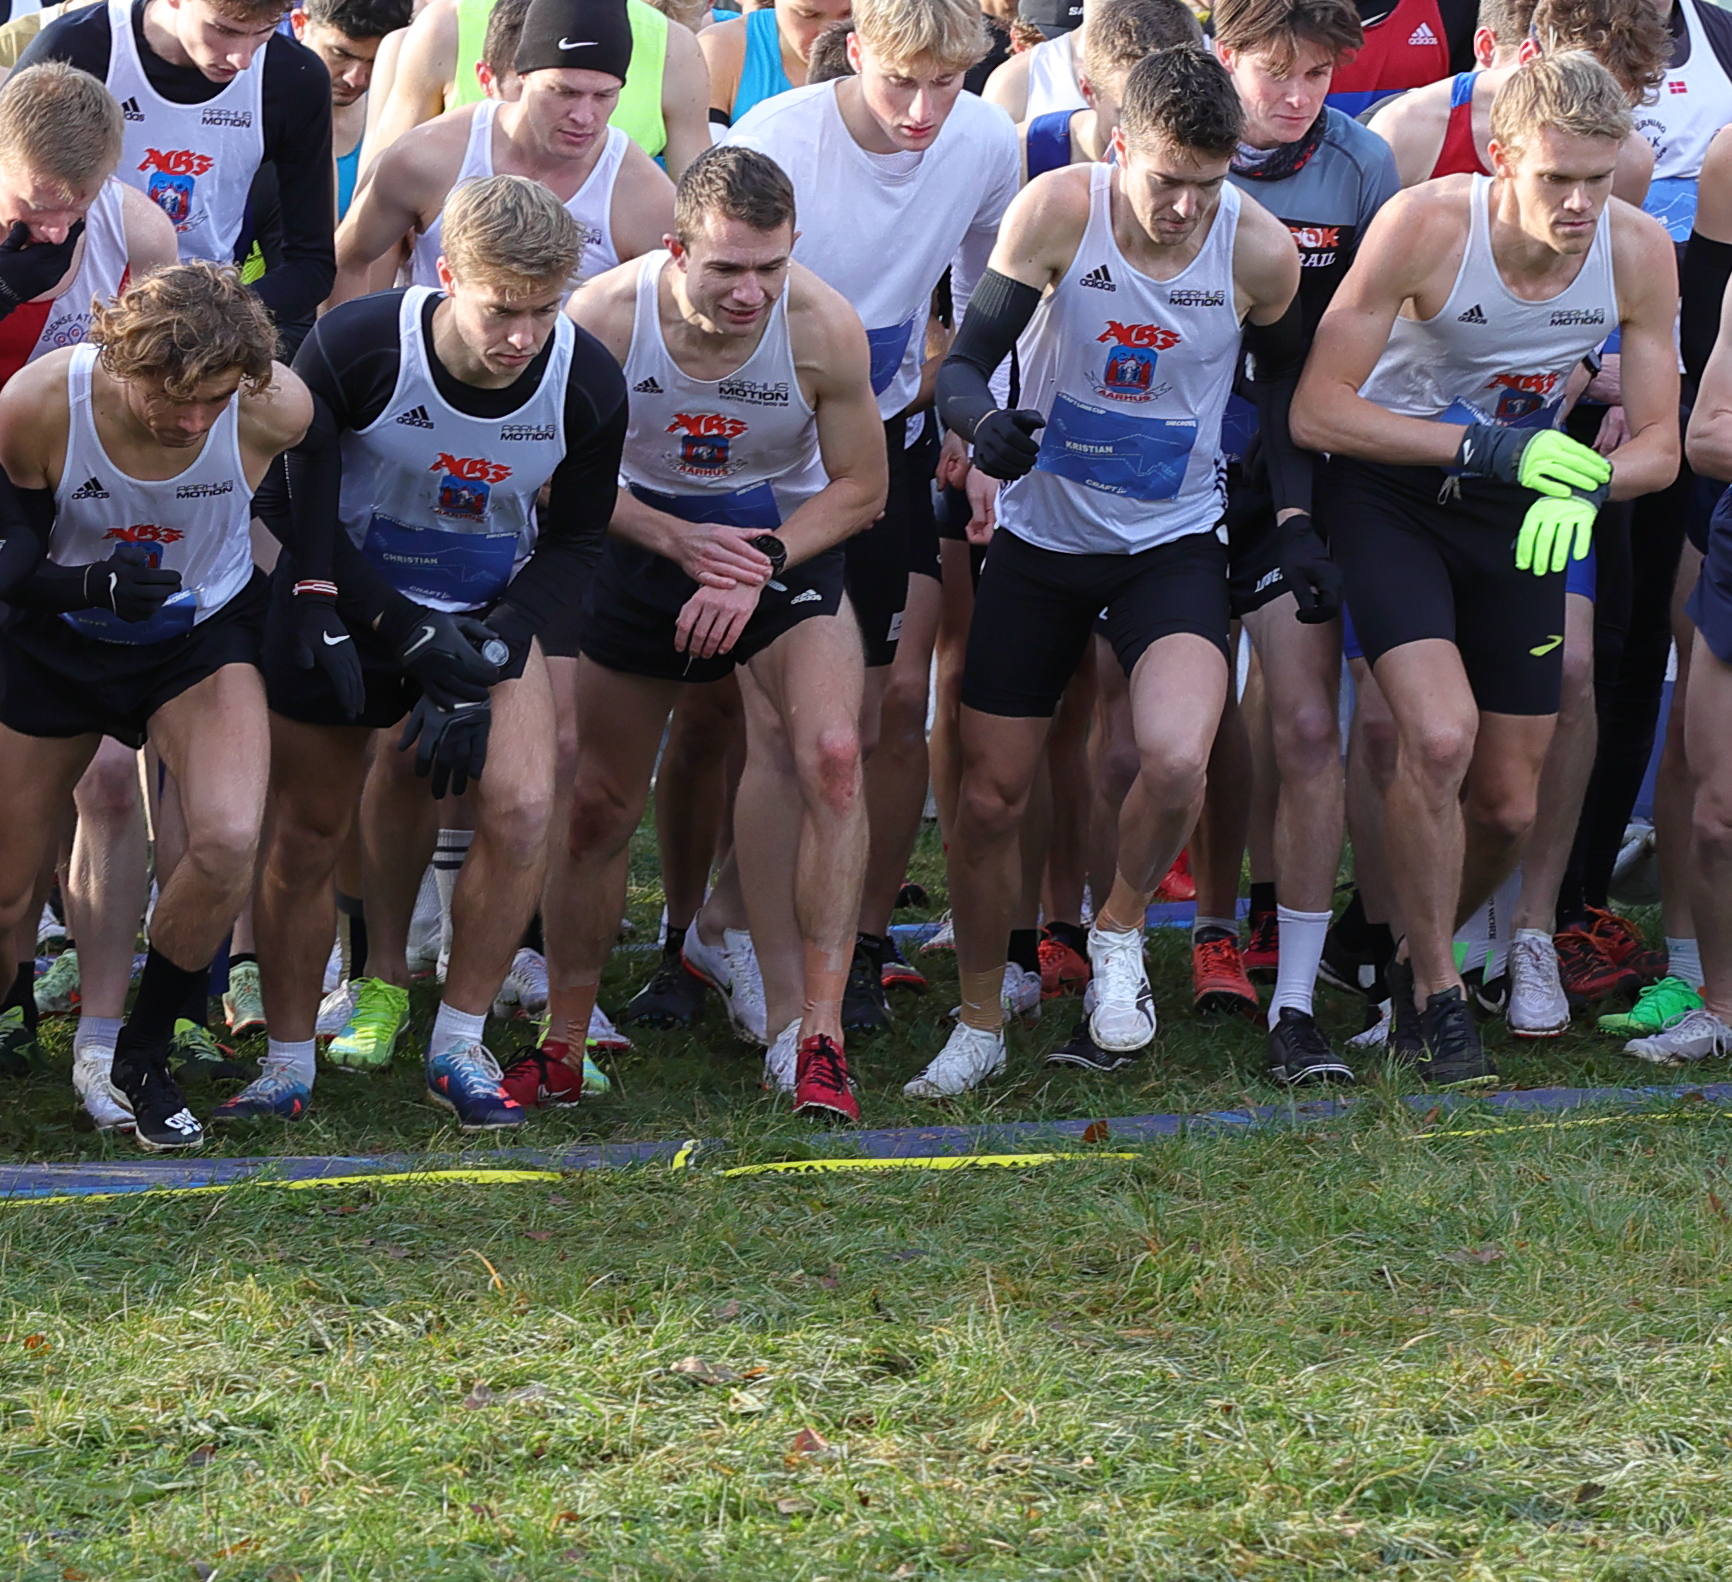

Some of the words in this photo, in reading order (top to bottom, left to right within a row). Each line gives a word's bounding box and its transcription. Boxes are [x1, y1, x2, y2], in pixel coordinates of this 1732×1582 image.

[1408, 37, 1438, 46] adidas
[202, 108, 252, 119] AARHUS
[201, 116, 251, 128] MOTION
[1079, 277, 1117, 293] adidas
[1170, 289, 1225, 299] AARHUS
[1169, 298, 1225, 307] MOTION
[1458, 316, 1488, 325] adidas
[1550, 317, 1604, 327] MOTION
[42, 316, 74, 343] ODENSE
[633, 386, 665, 394] adidas
[718, 379, 788, 392] AARHUS
[718, 387, 788, 401] MOTION
[1098, 388, 1151, 402] AARHUS
[396, 416, 435, 430] adidas
[502, 424, 557, 433] AARHUS
[500, 432, 556, 441] MOTION
[1065, 439, 1114, 454] KRISTIAN
[678, 464, 728, 478] AARHUS
[177, 480, 234, 492] AARHUS
[1084, 478, 1118, 492] CRAFT
[71, 490, 111, 500] adidas
[176, 486, 234, 499] MOTION
[382, 552, 439, 565] CHRISTIAN
